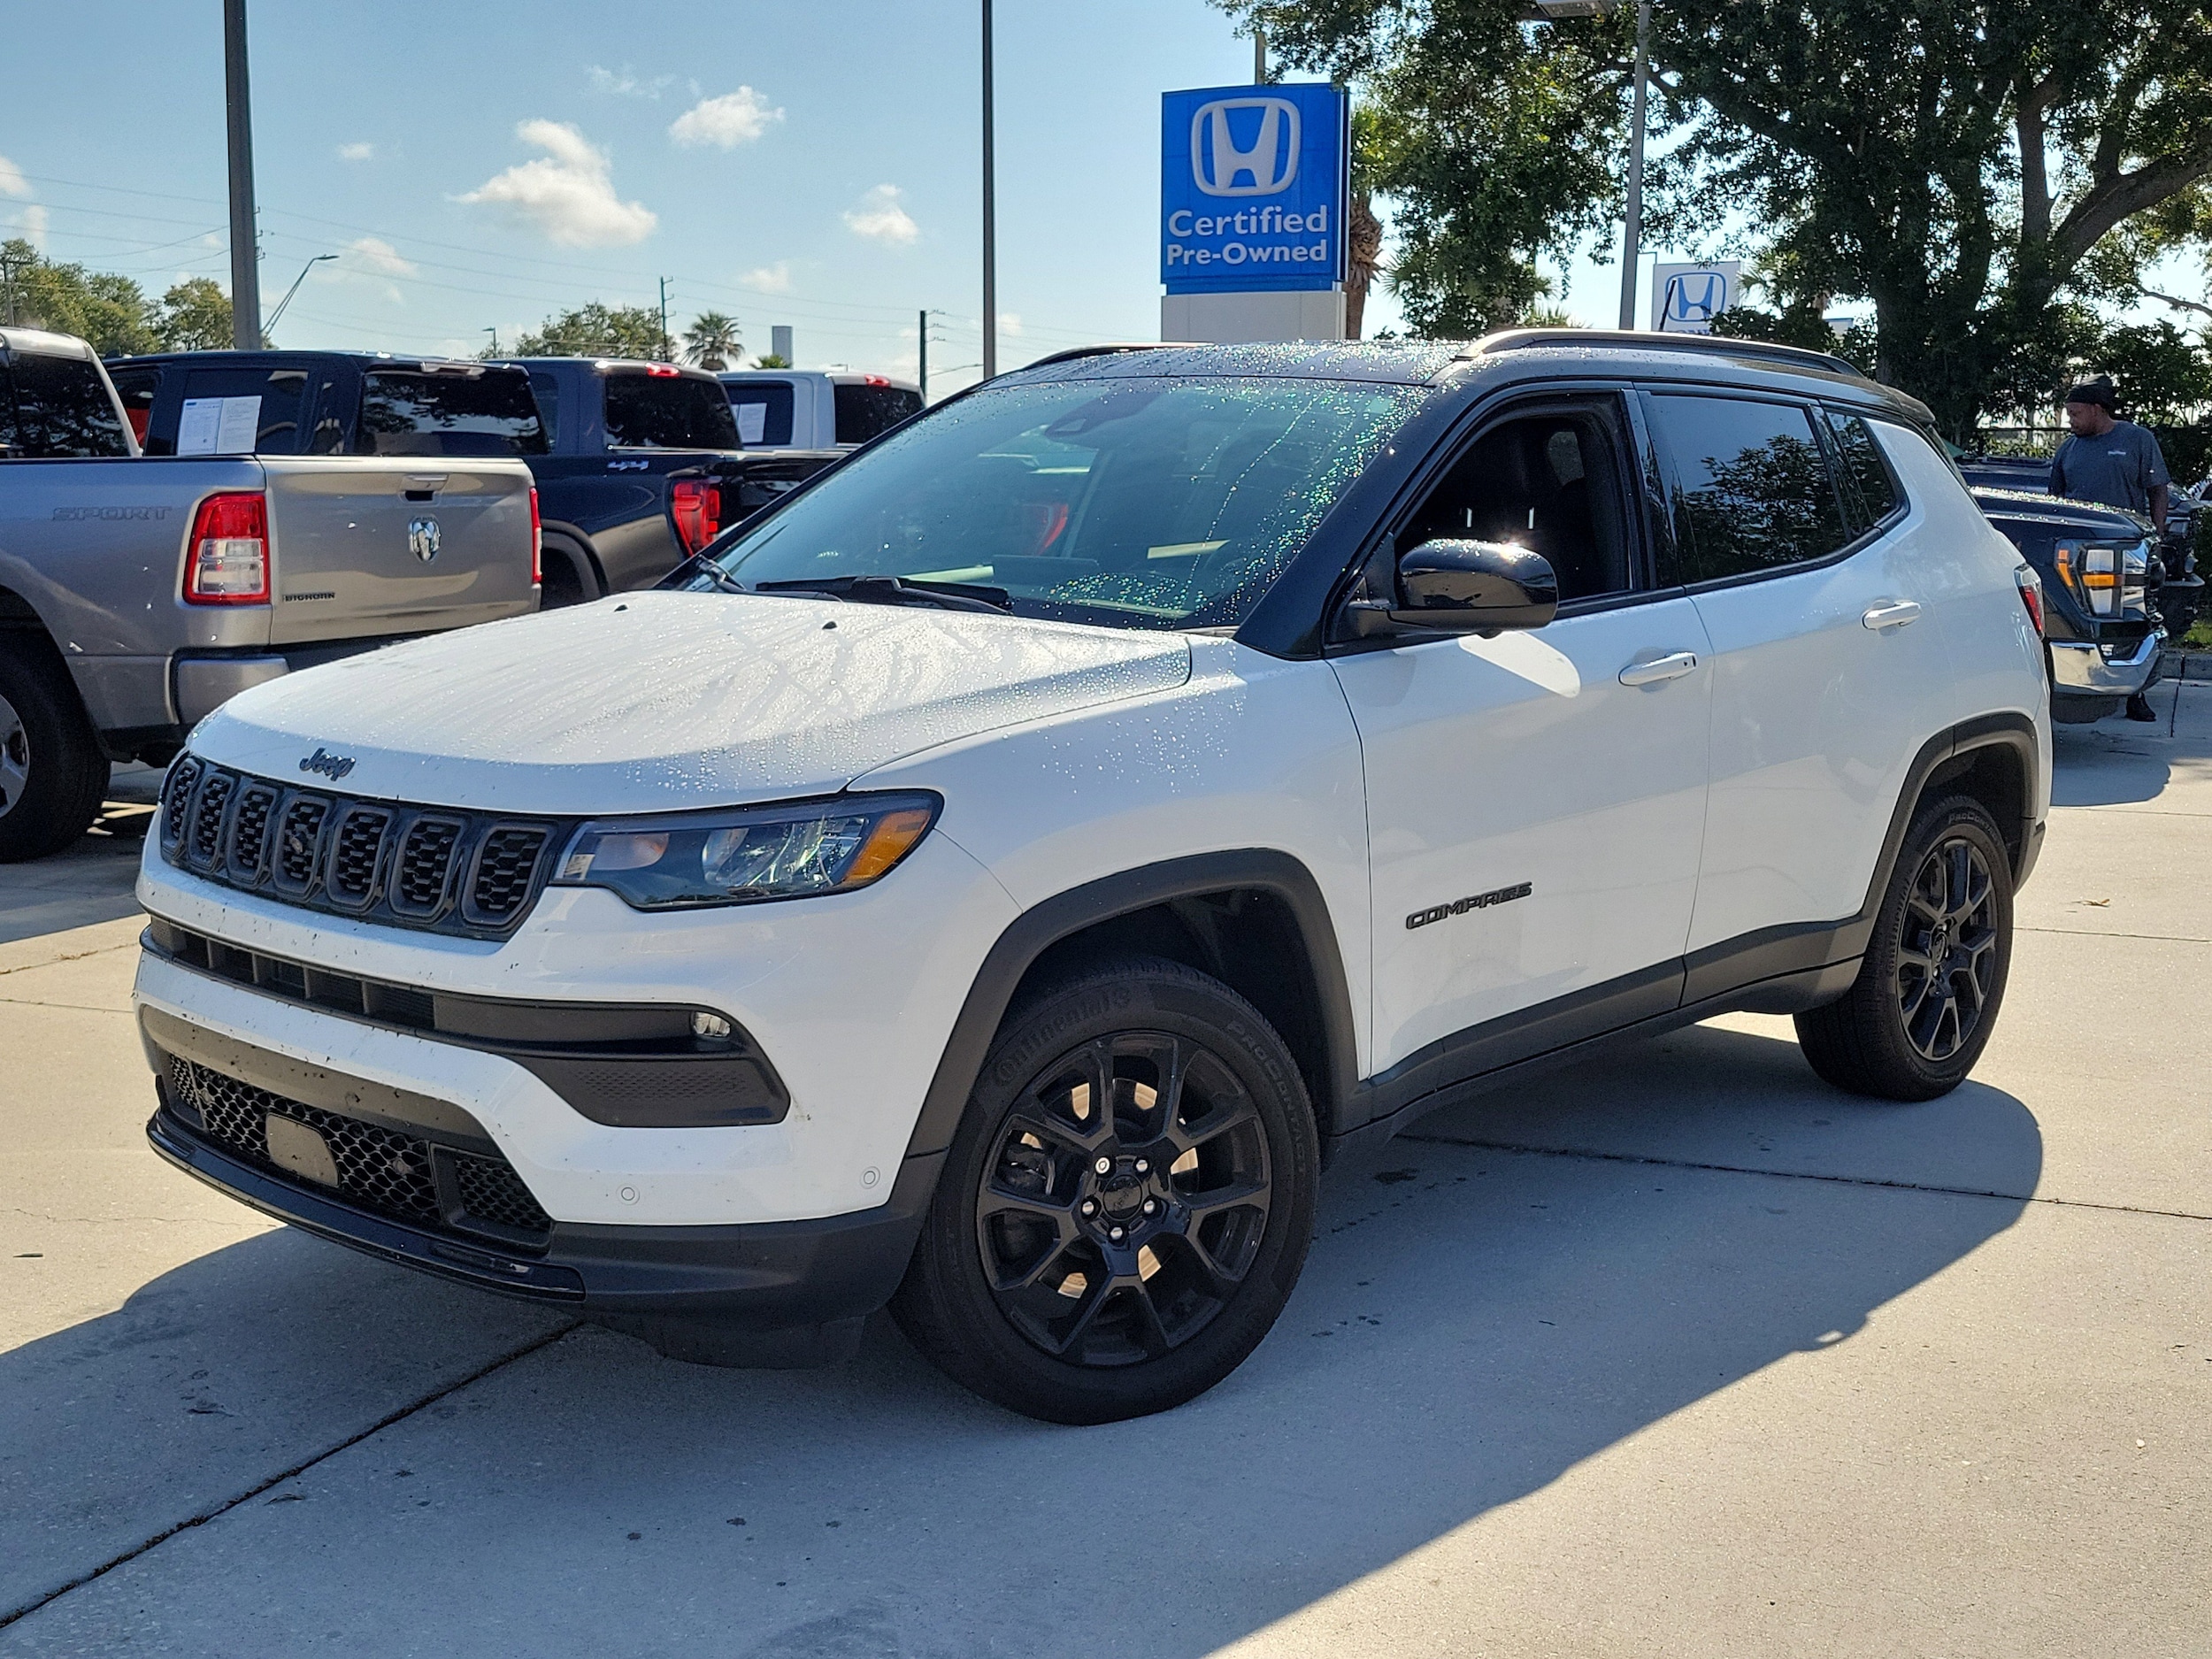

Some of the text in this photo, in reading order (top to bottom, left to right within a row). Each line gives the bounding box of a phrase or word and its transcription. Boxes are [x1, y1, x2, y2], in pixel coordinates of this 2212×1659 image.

[1168, 204, 1328, 237] Certified
[1166, 239, 1328, 266] Pre-Owned
[52, 505, 173, 521] SPORT
[299, 747, 356, 782] Jeep
[1405, 881, 1533, 930] COMPASS
